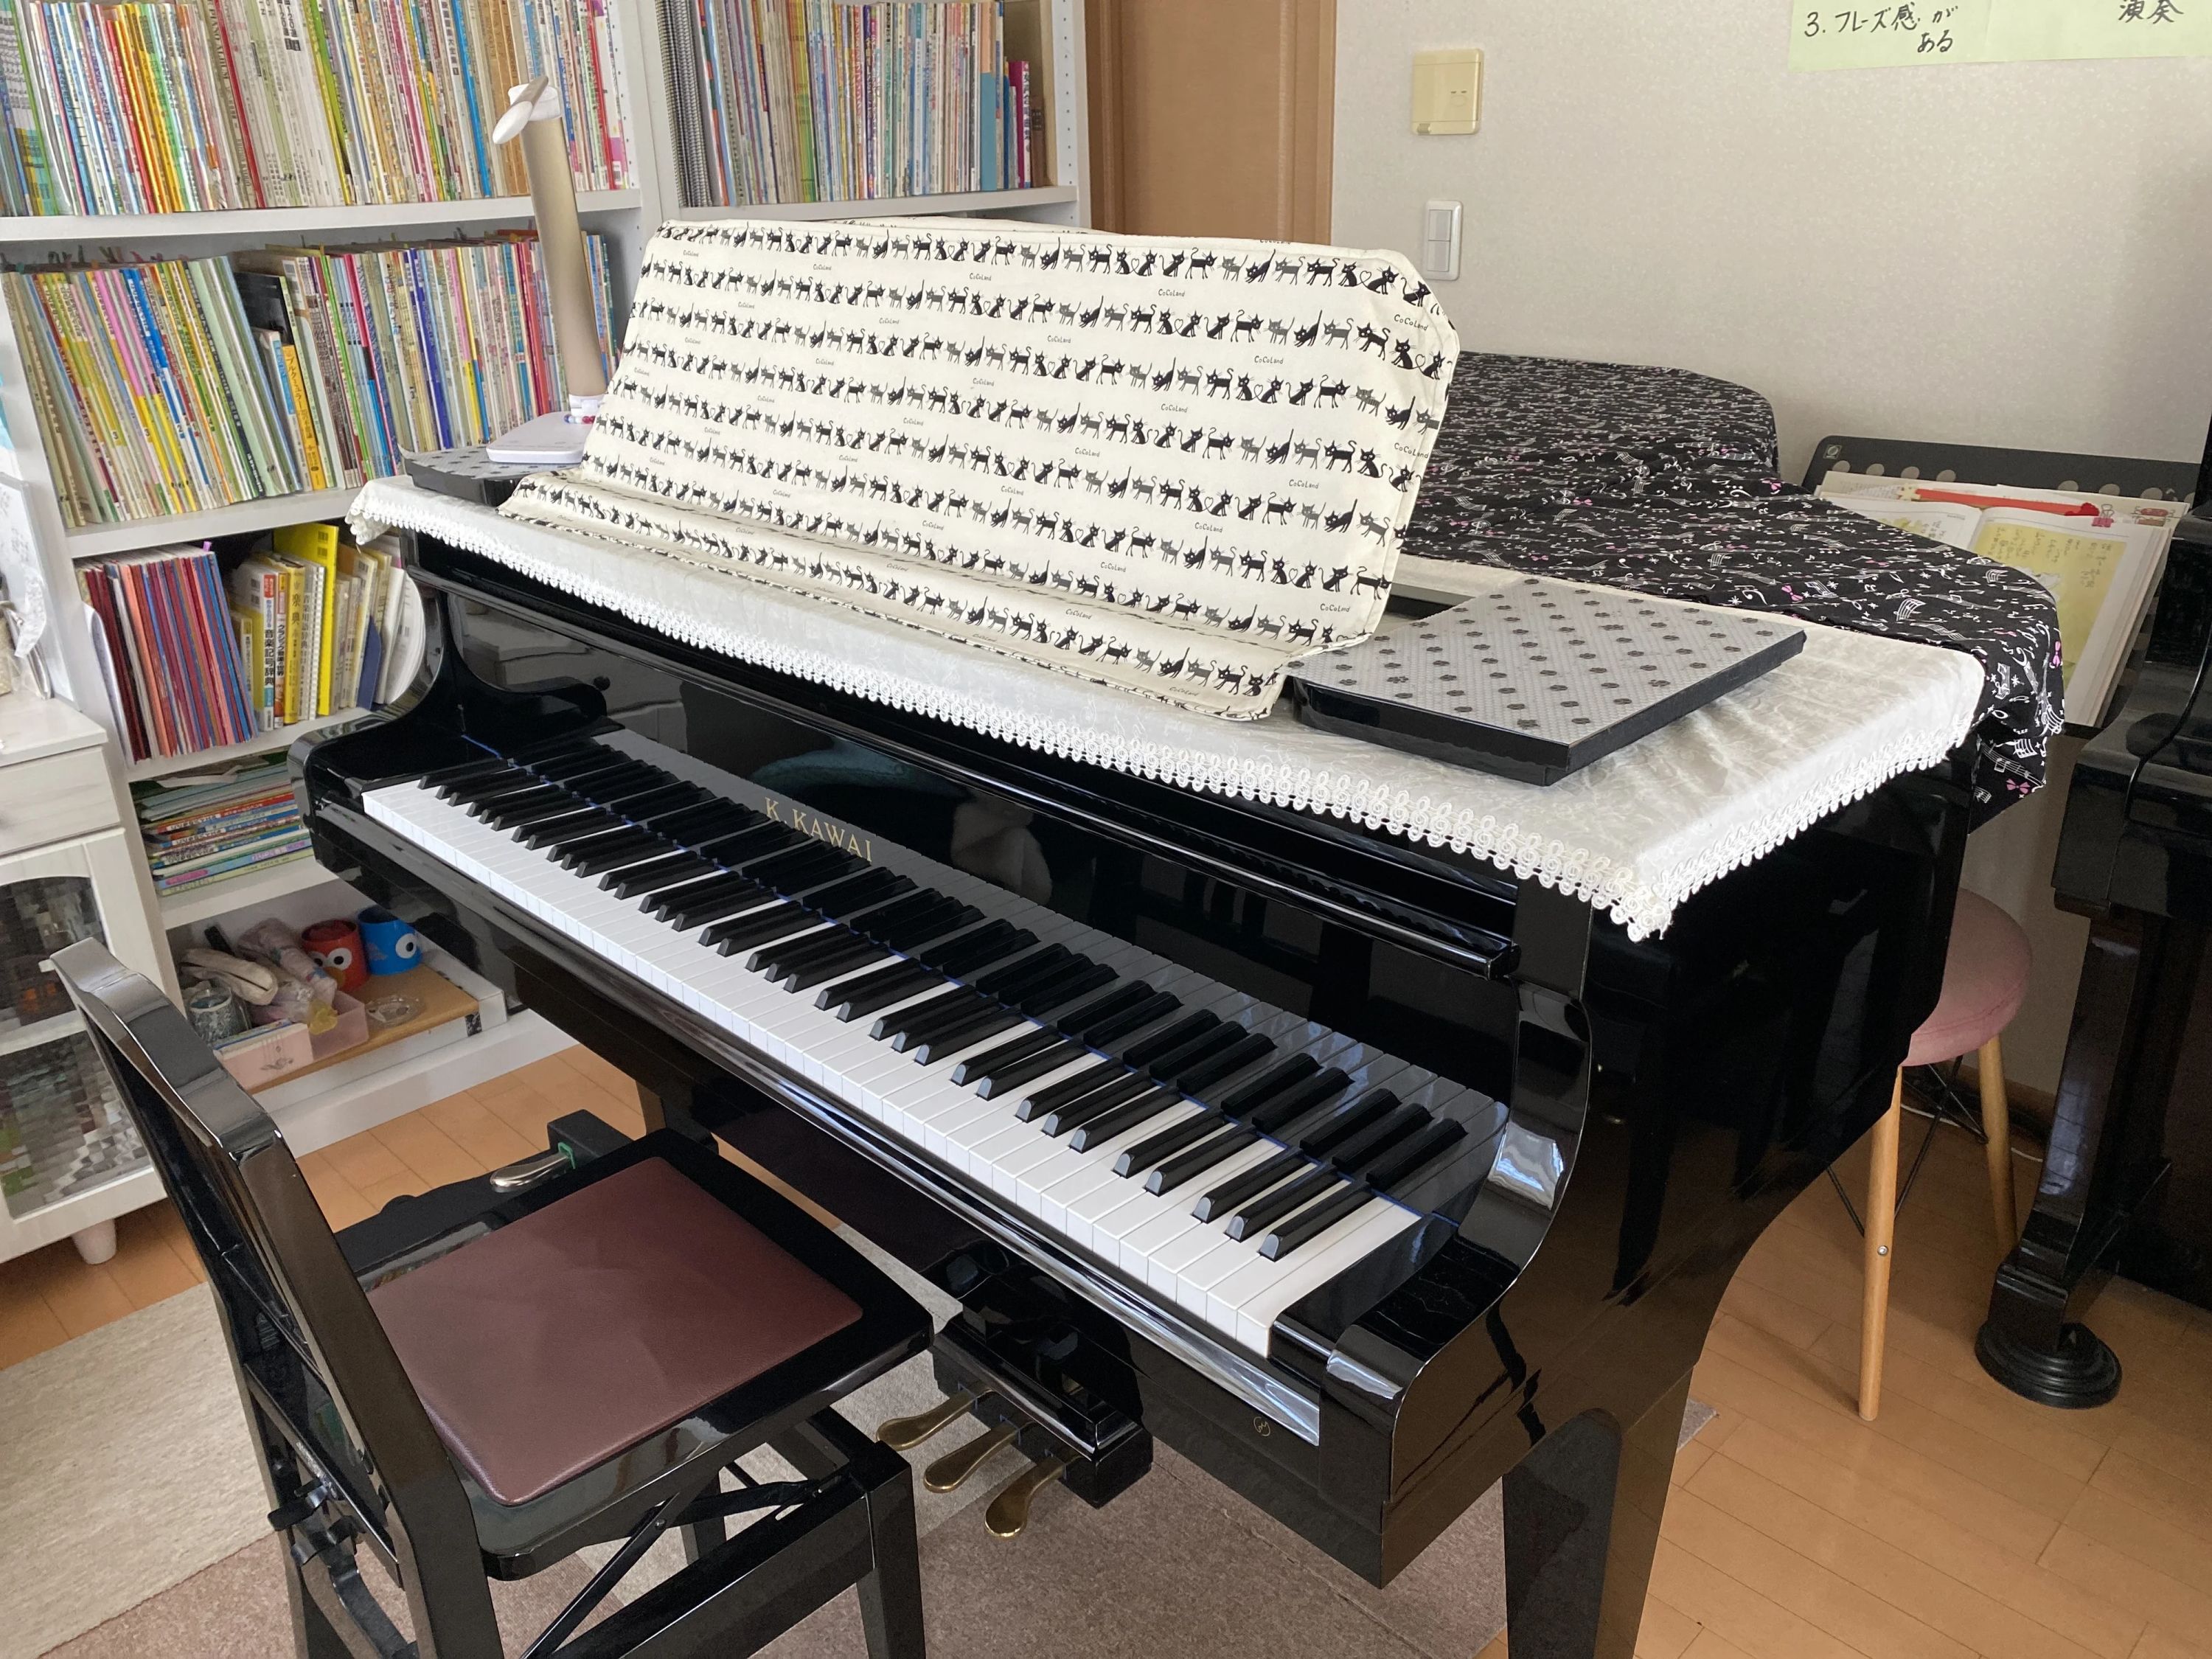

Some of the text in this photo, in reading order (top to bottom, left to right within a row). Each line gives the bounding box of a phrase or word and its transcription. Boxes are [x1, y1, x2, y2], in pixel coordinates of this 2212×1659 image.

[1917, 29, 1953, 53] ある
[970, 273, 991, 281] CoCoLand
[1158, 288, 1185, 296] CoCoLand
[1394, 314, 1428, 331] CoCoLand
[1048, 335, 1071, 343] CoCoLand
[1254, 355, 1284, 364] CoCoLand
[973, 378, 994, 387] CoCoLand
[1161, 403, 1188, 413] CoCoLand
[1075, 448, 1100, 457] CoCoLand
[1394, 442, 1428, 458] CoCoLand
[1289, 479, 1318, 489] CoCoLand
[1001, 485, 1023, 495] CoCoLand
[922, 521, 944, 530] CoCoLand
[1195, 522, 1222, 532] CoCoLand
[1101, 562, 1126, 572] CoCoLand
[1321, 603, 1350, 612] CoCoLand
[1066, 609, 1091, 619] CoCoLand
[265, 630, 274, 686] 音楽記号辞典
